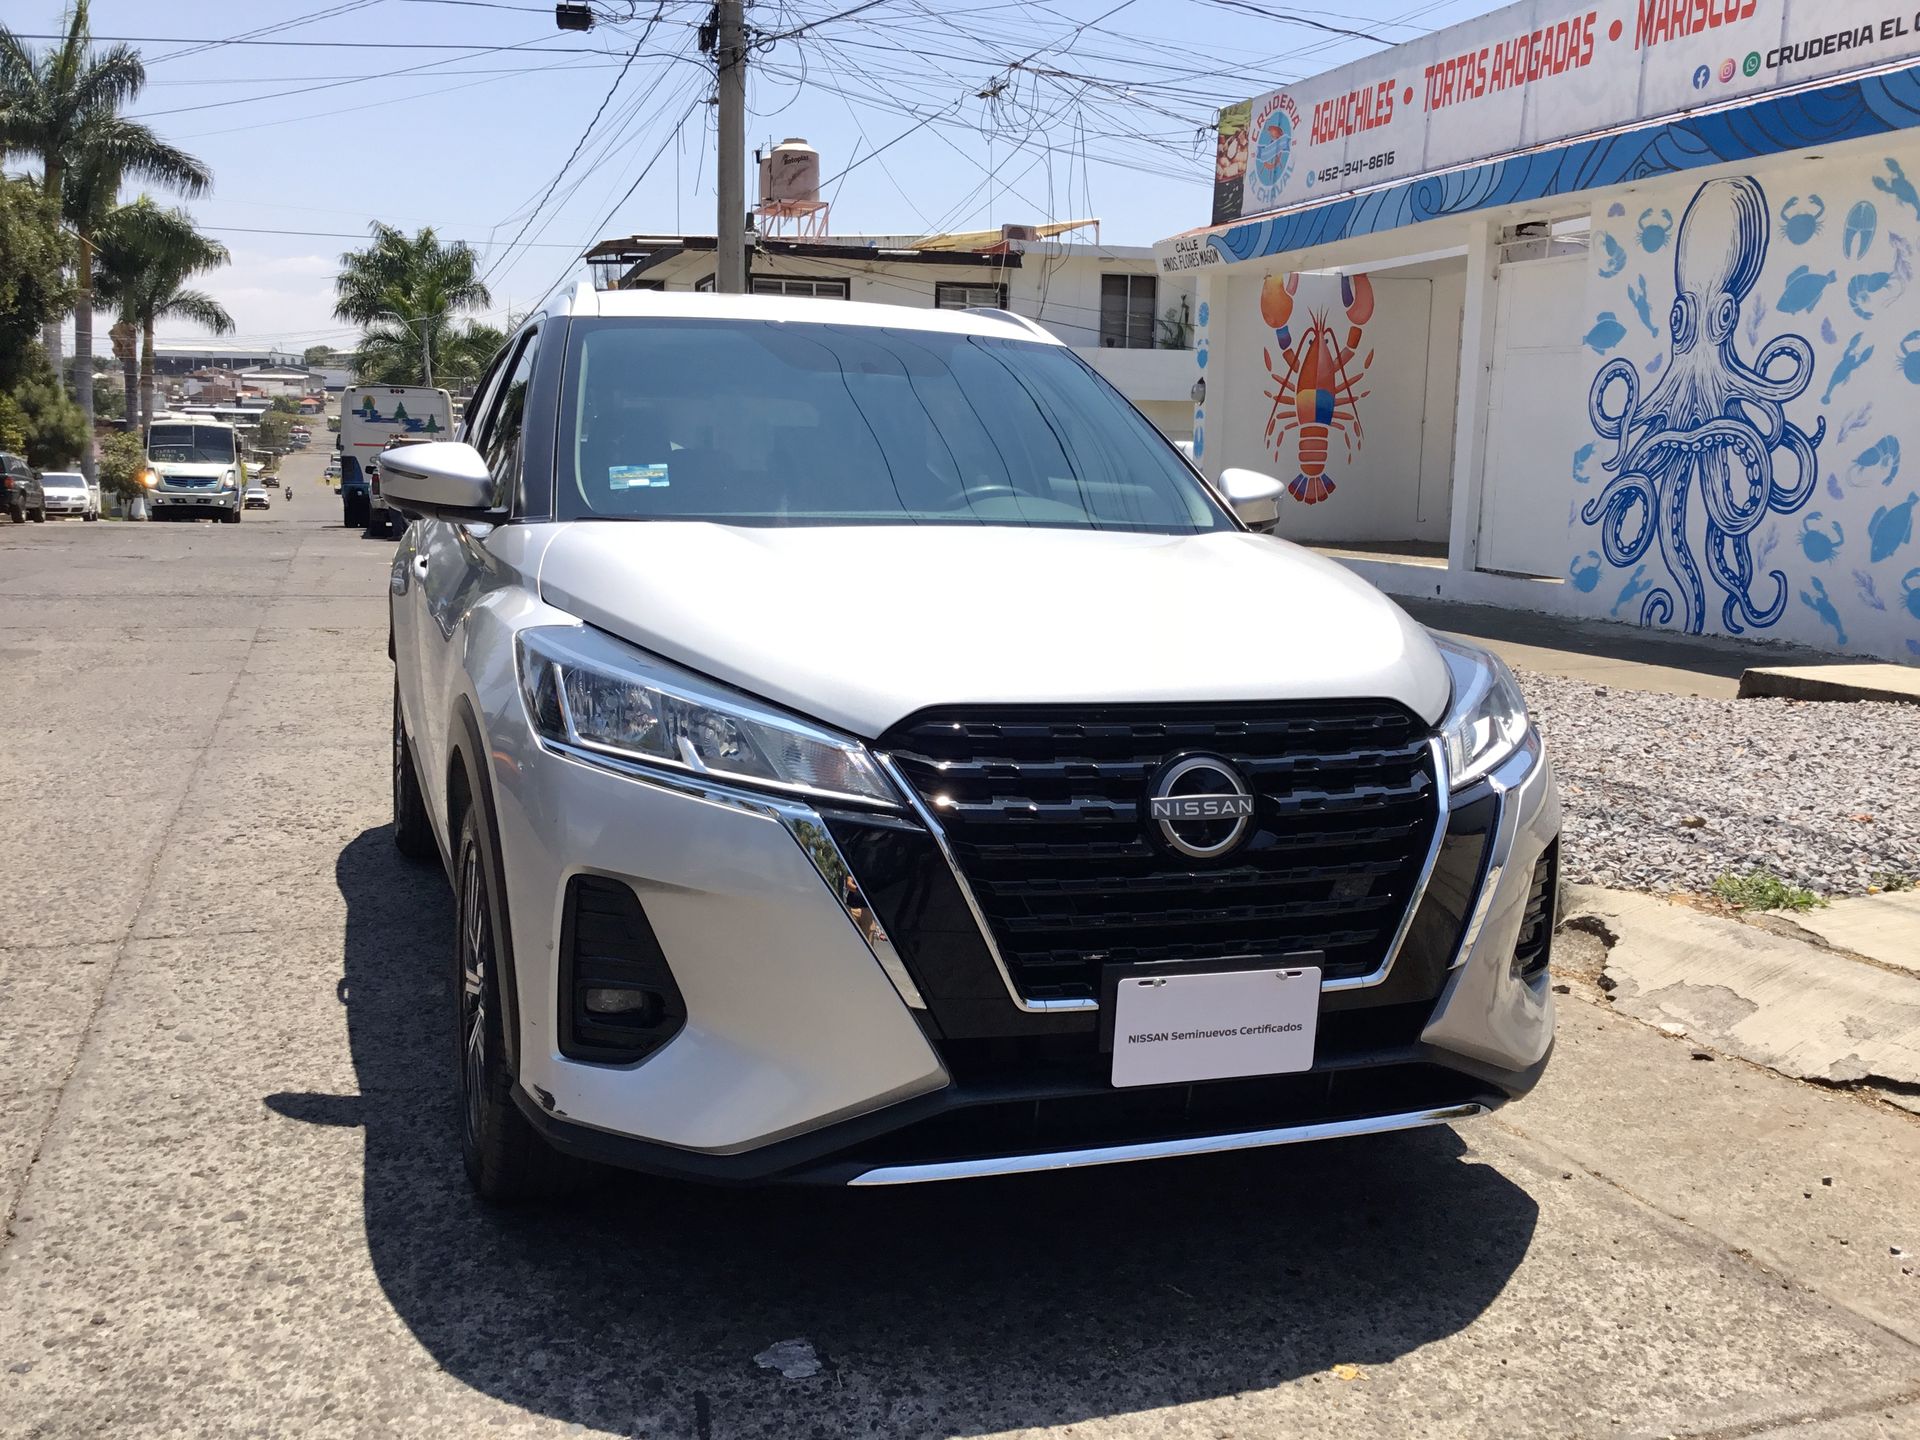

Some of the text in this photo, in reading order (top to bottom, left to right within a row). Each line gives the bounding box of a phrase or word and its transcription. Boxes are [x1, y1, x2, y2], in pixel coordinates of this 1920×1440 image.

[1766, 25, 1874, 69] CRUDERIA
[1880, 16, 1909, 41] EL
[1310, 79, 1397, 147] AGUACHILES
[1424, 47, 1489, 113] TORTAS
[1489, 11, 1597, 94] AHOGADAS
[1251, 93, 1301, 142] CRUDERIA
[1318, 151, 1396, 182] 452-341-8616
[1175, 239, 1199, 253] CALLE
[1179, 252, 1200, 270] FLORES
[1154, 799, 1252, 816] NISSAN
[1128, 1022, 1303, 1044] NISSAN Seminuevos Certificados
